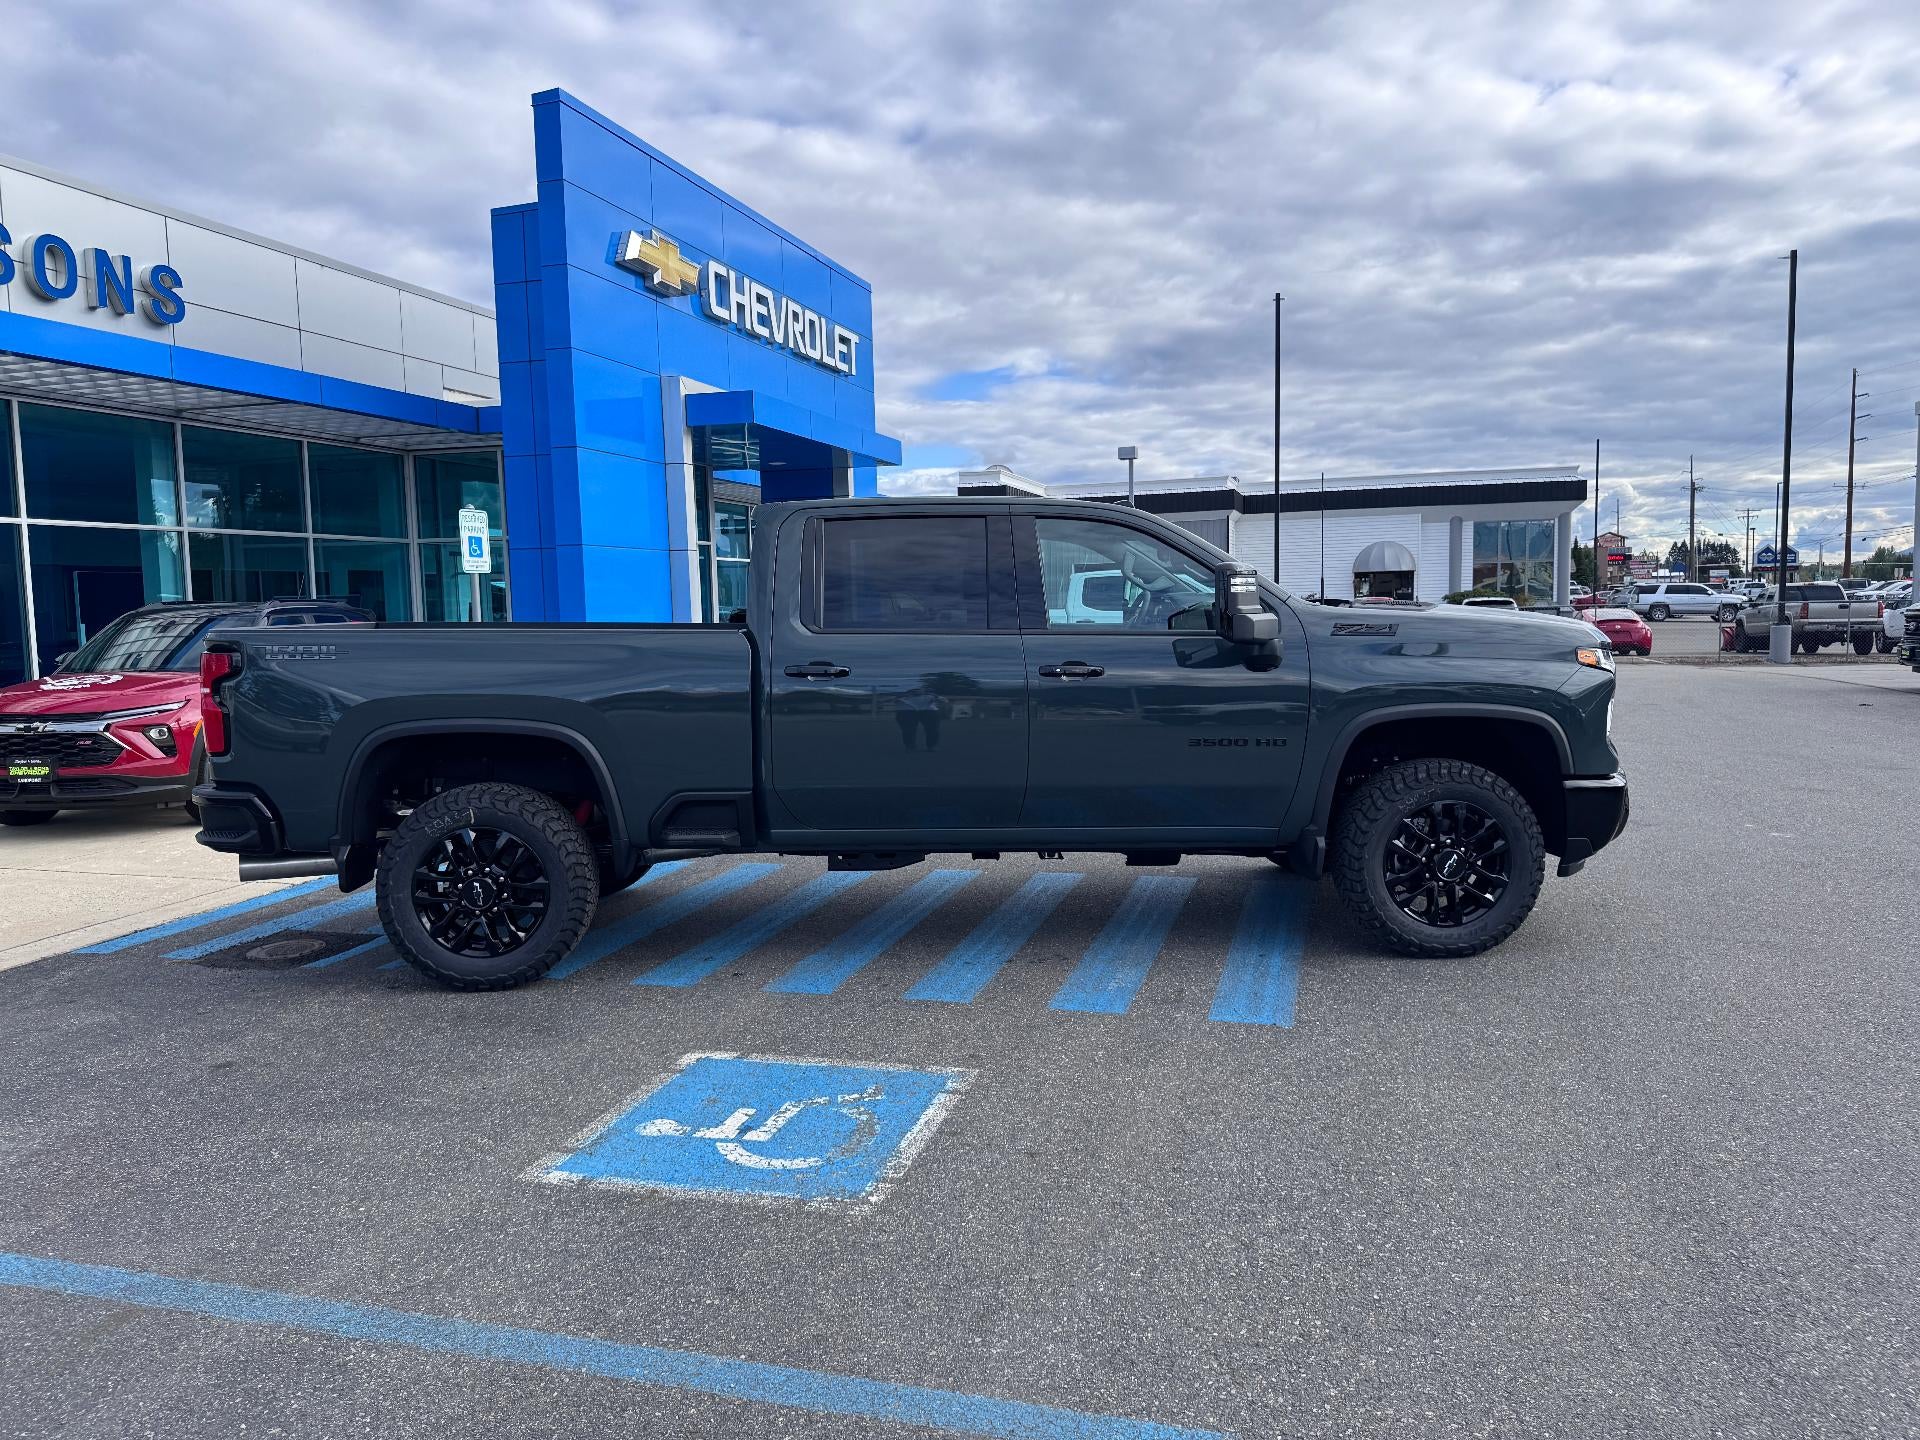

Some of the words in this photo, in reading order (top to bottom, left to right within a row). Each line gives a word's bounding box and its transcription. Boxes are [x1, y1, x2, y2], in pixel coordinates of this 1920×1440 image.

[703, 260, 860, 376] CHEVROLET
[462, 514, 485, 524] RESERVED
[464, 525, 485, 535] PARKING
[253, 645, 349, 654] TRAIL
[1188, 738, 1249, 747] 3500
[1256, 738, 1287, 747] HD
